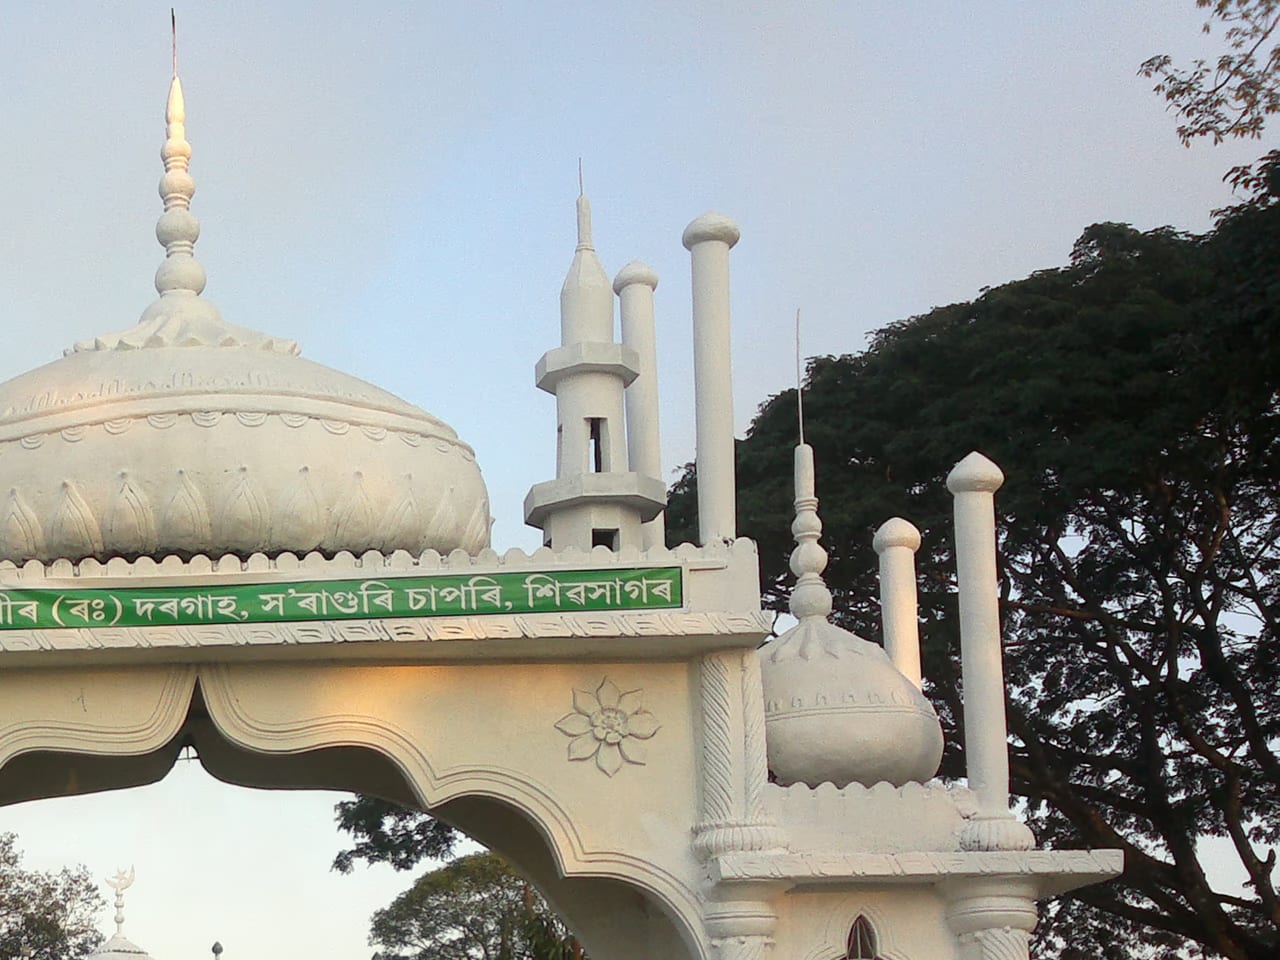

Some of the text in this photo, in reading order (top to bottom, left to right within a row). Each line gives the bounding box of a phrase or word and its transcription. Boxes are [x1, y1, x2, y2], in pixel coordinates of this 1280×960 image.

[132, 594, 250, 622] দৰগাহ,
[404, 576, 513, 612] চাপৰি,
[522, 574, 673, 608] শিৱসাগৰ
